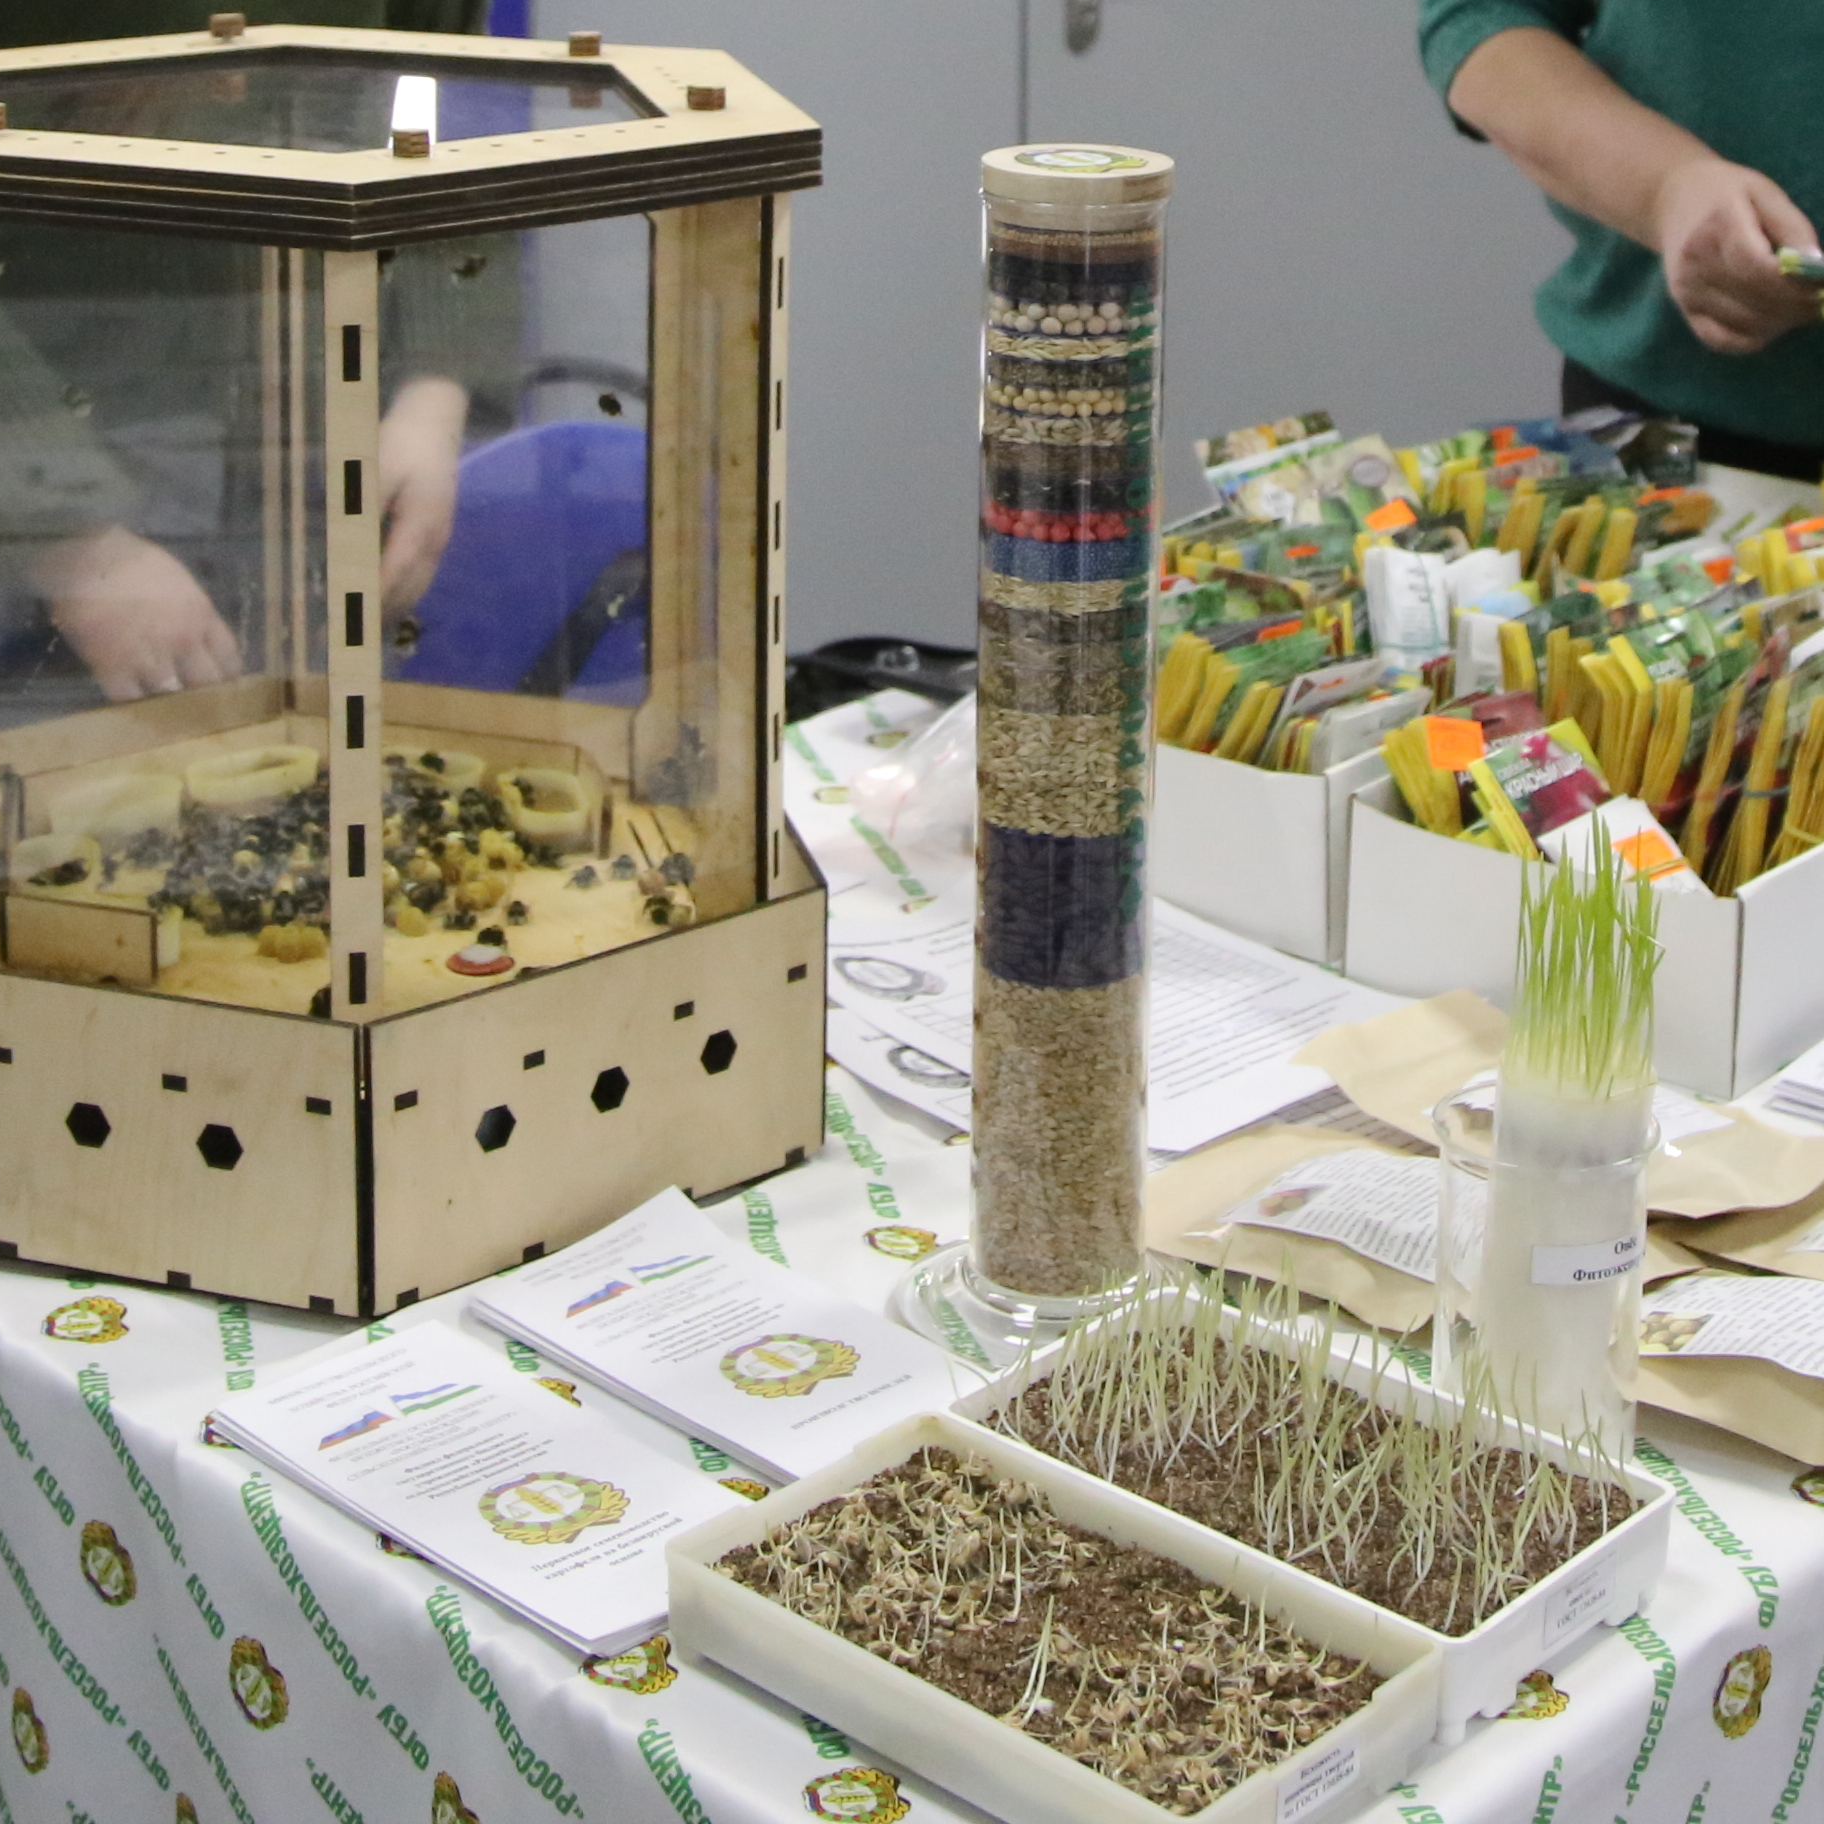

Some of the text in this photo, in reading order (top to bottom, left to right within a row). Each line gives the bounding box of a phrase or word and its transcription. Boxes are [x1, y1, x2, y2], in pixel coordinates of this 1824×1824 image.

[33, 1466, 76, 1526] ФГБУ
[185, 1573, 225, 1639] ФГБУ
[1738, 1566, 1780, 1630] ФГБУ
[127, 1730, 170, 1792] ФГБУ
[376, 1703, 431, 1771] ФГБУ
